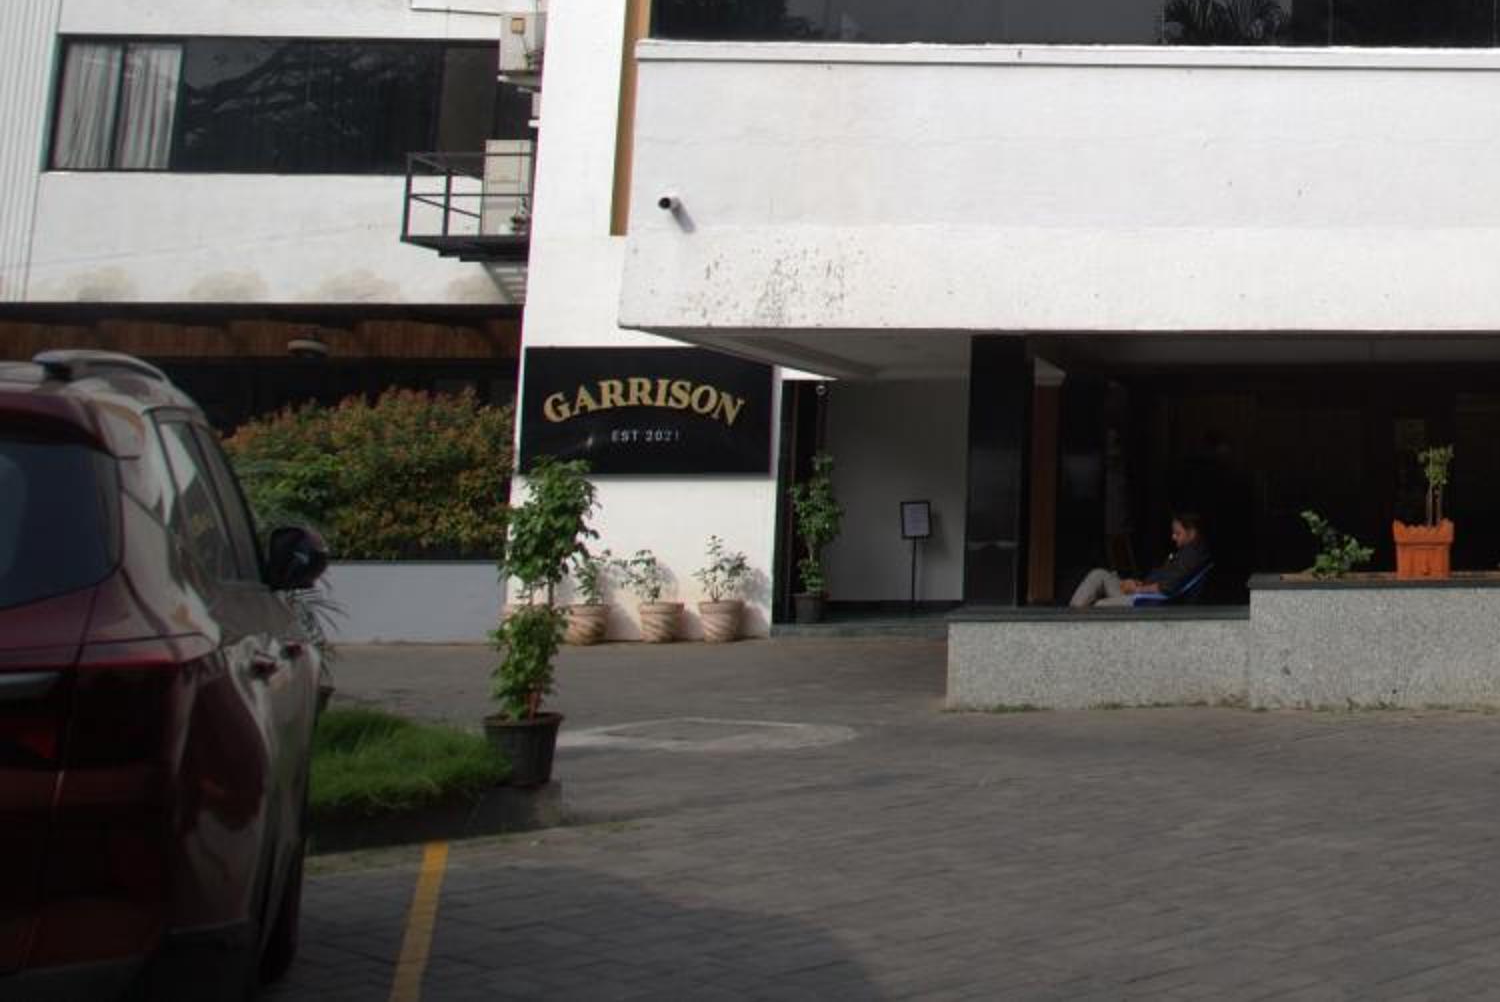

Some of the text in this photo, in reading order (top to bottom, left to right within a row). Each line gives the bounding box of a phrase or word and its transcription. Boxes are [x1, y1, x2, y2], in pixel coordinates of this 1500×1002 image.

[543, 377, 745, 425] GARRISON
[611, 429, 680, 442] EST 2021
